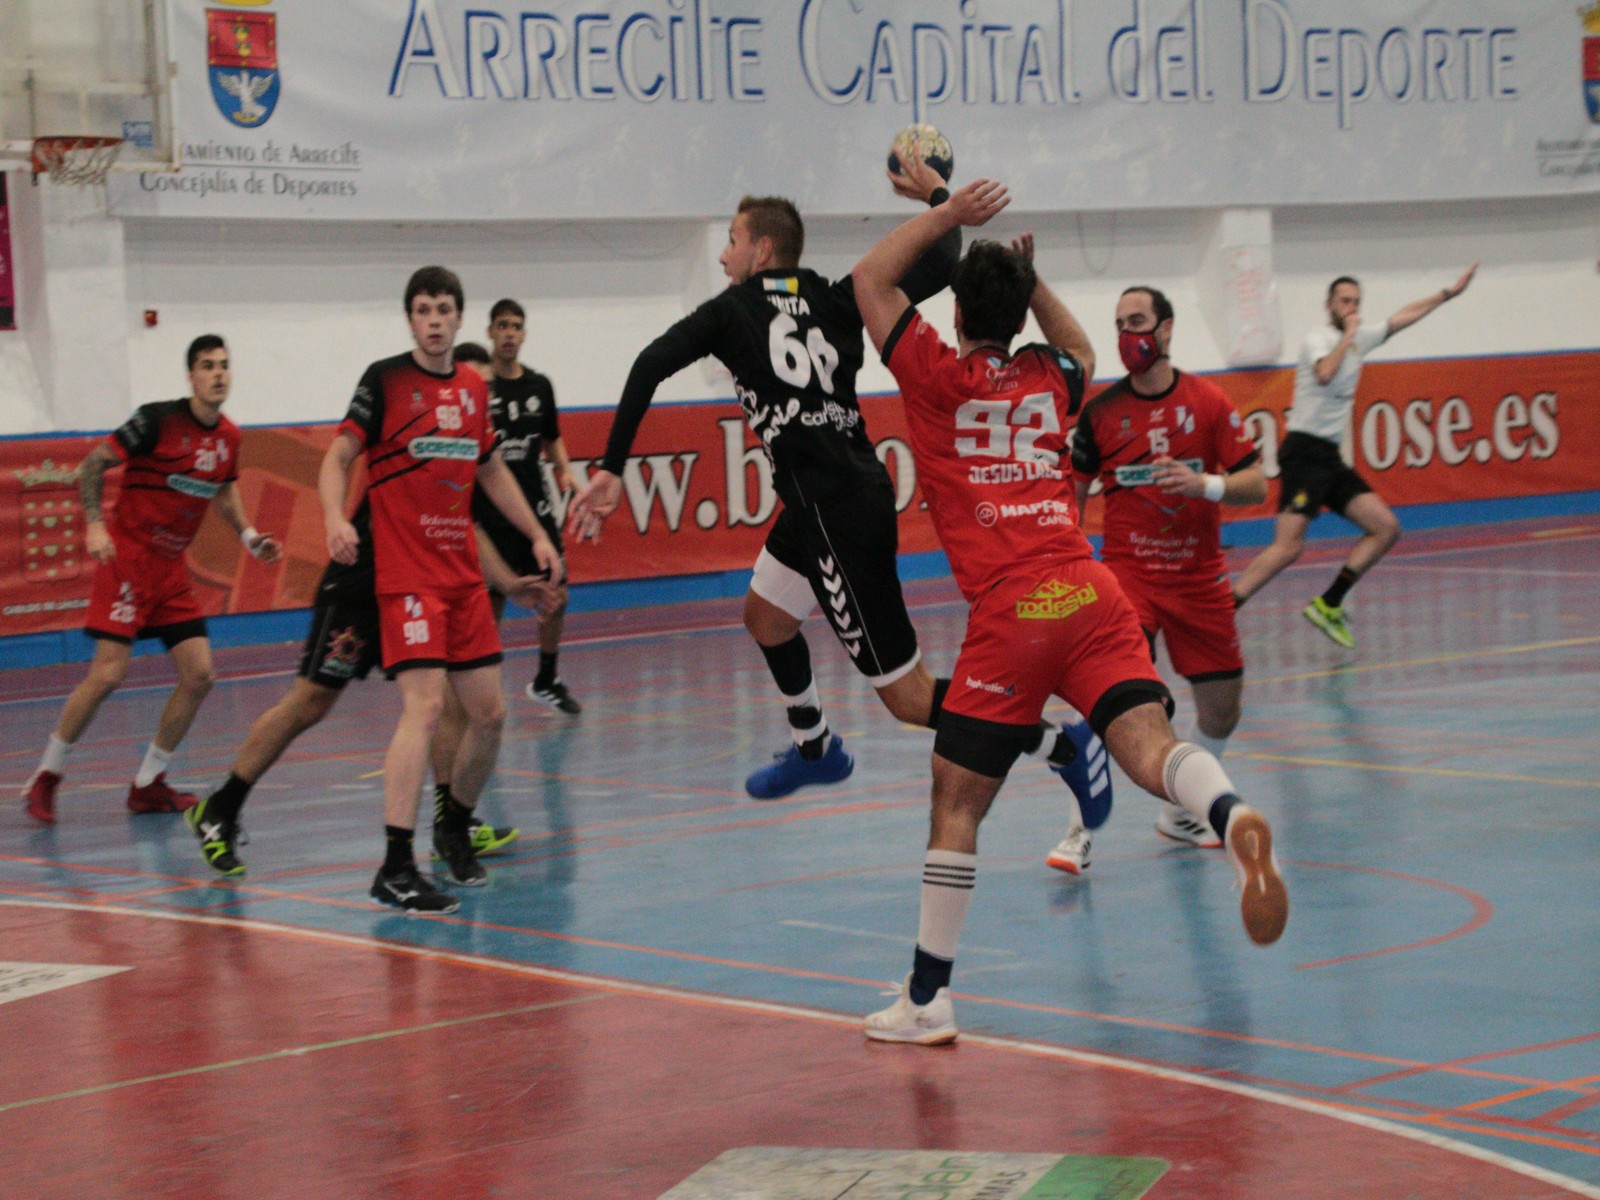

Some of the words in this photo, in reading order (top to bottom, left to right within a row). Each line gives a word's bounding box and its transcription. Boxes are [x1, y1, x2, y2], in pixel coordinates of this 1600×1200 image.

[955, 391, 1061, 467] 92
[1147, 427, 1170, 455] 15
[968, 463, 1023, 484] JESUS
